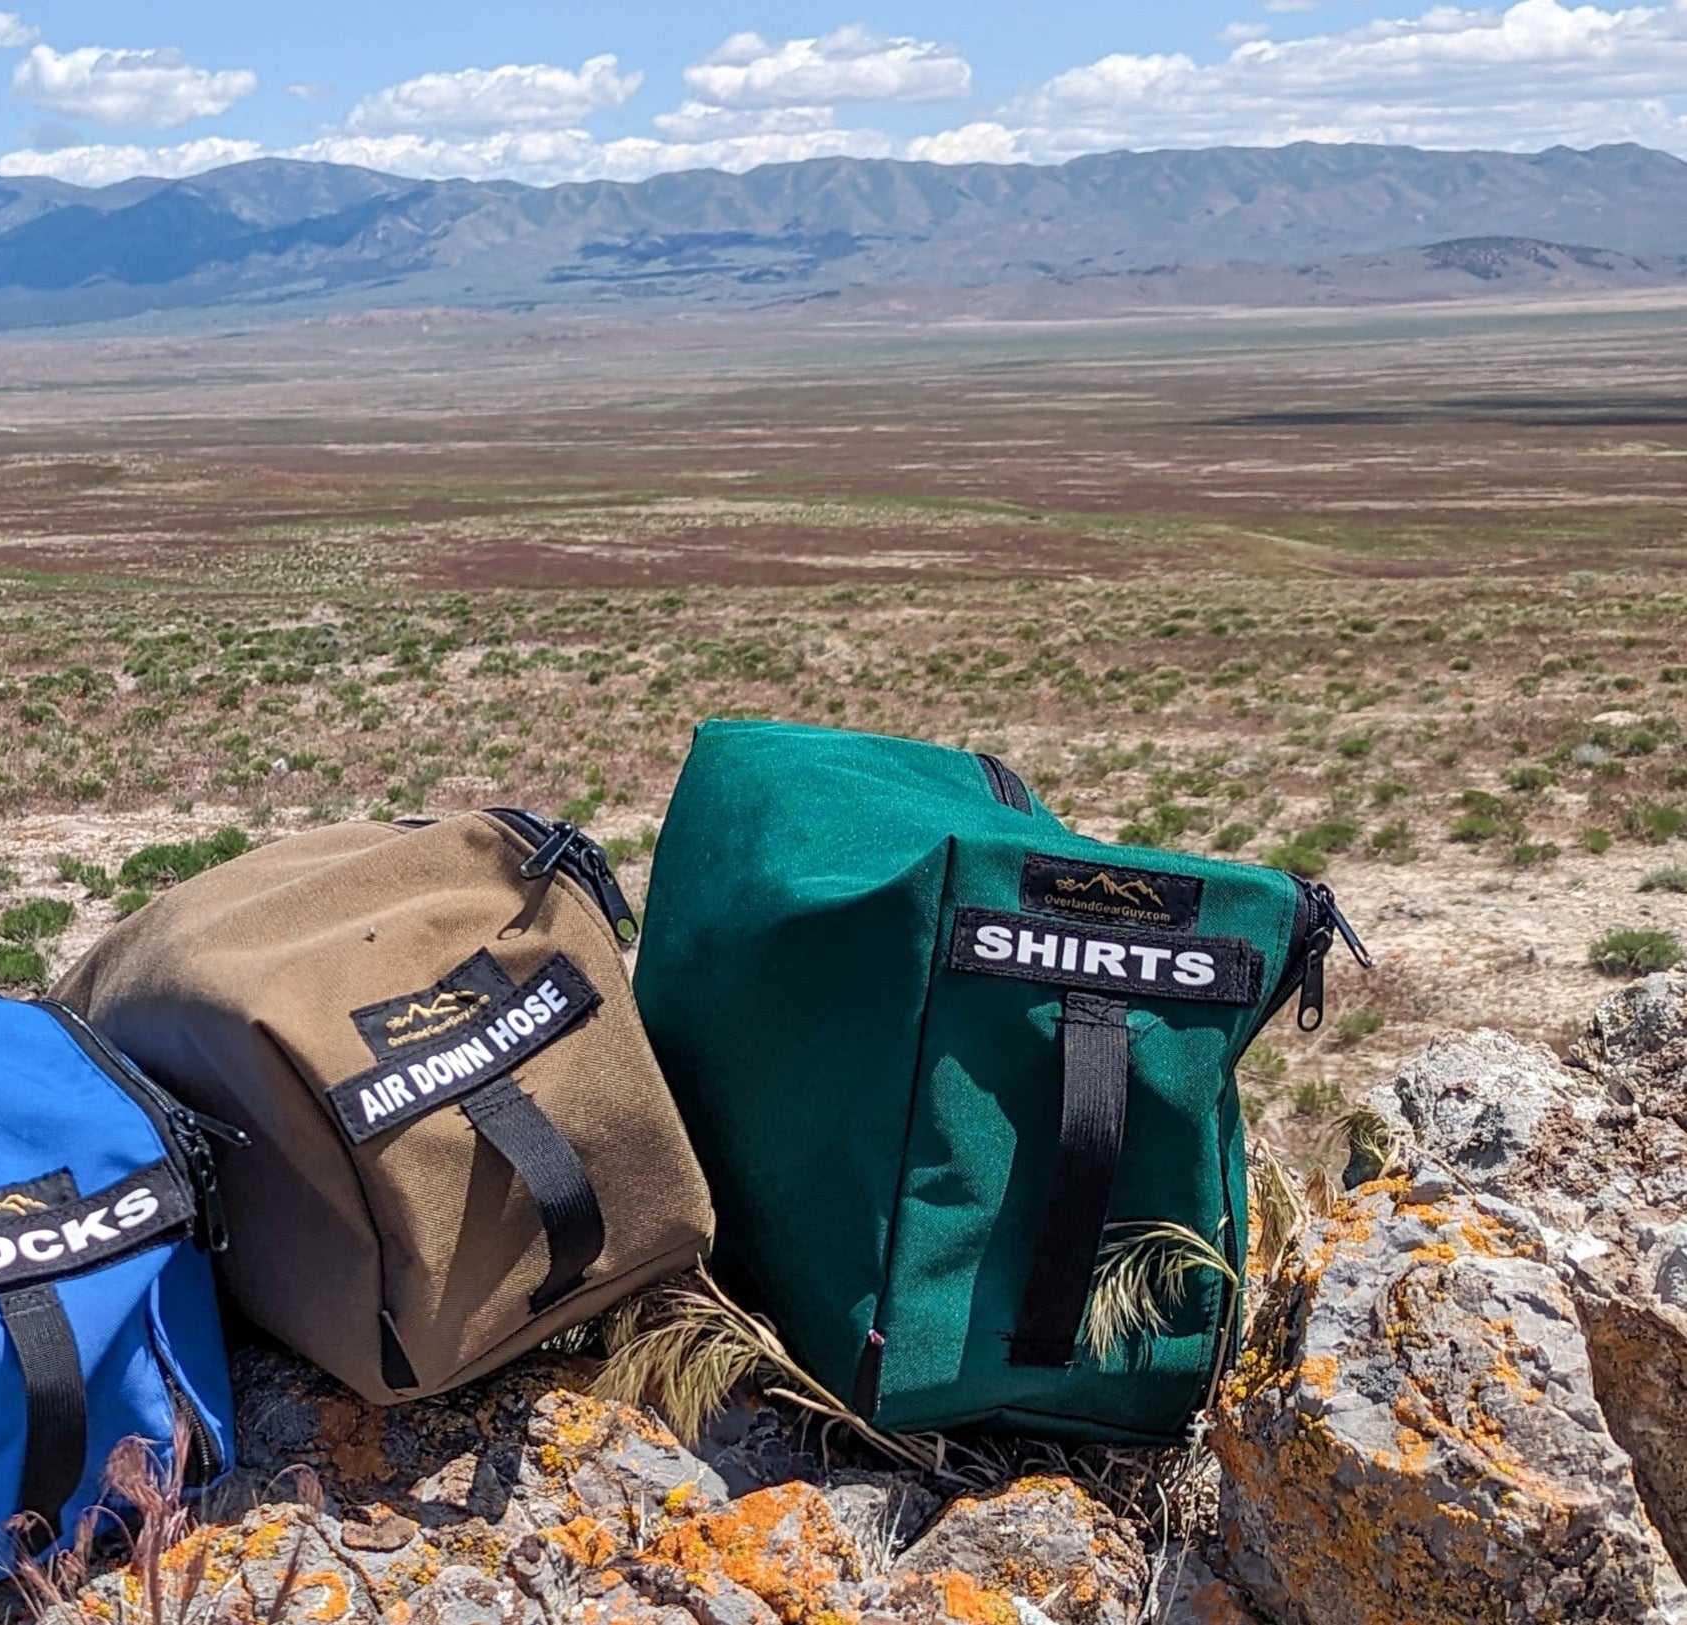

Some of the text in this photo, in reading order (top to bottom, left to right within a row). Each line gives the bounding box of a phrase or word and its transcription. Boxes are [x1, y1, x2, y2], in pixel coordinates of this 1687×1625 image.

[1043, 894, 1171, 922] OverlandGearGuy.com
[974, 925, 1215, 986] SHIRTS
[359, 979, 568, 1124] AIR DOWN HOSE
